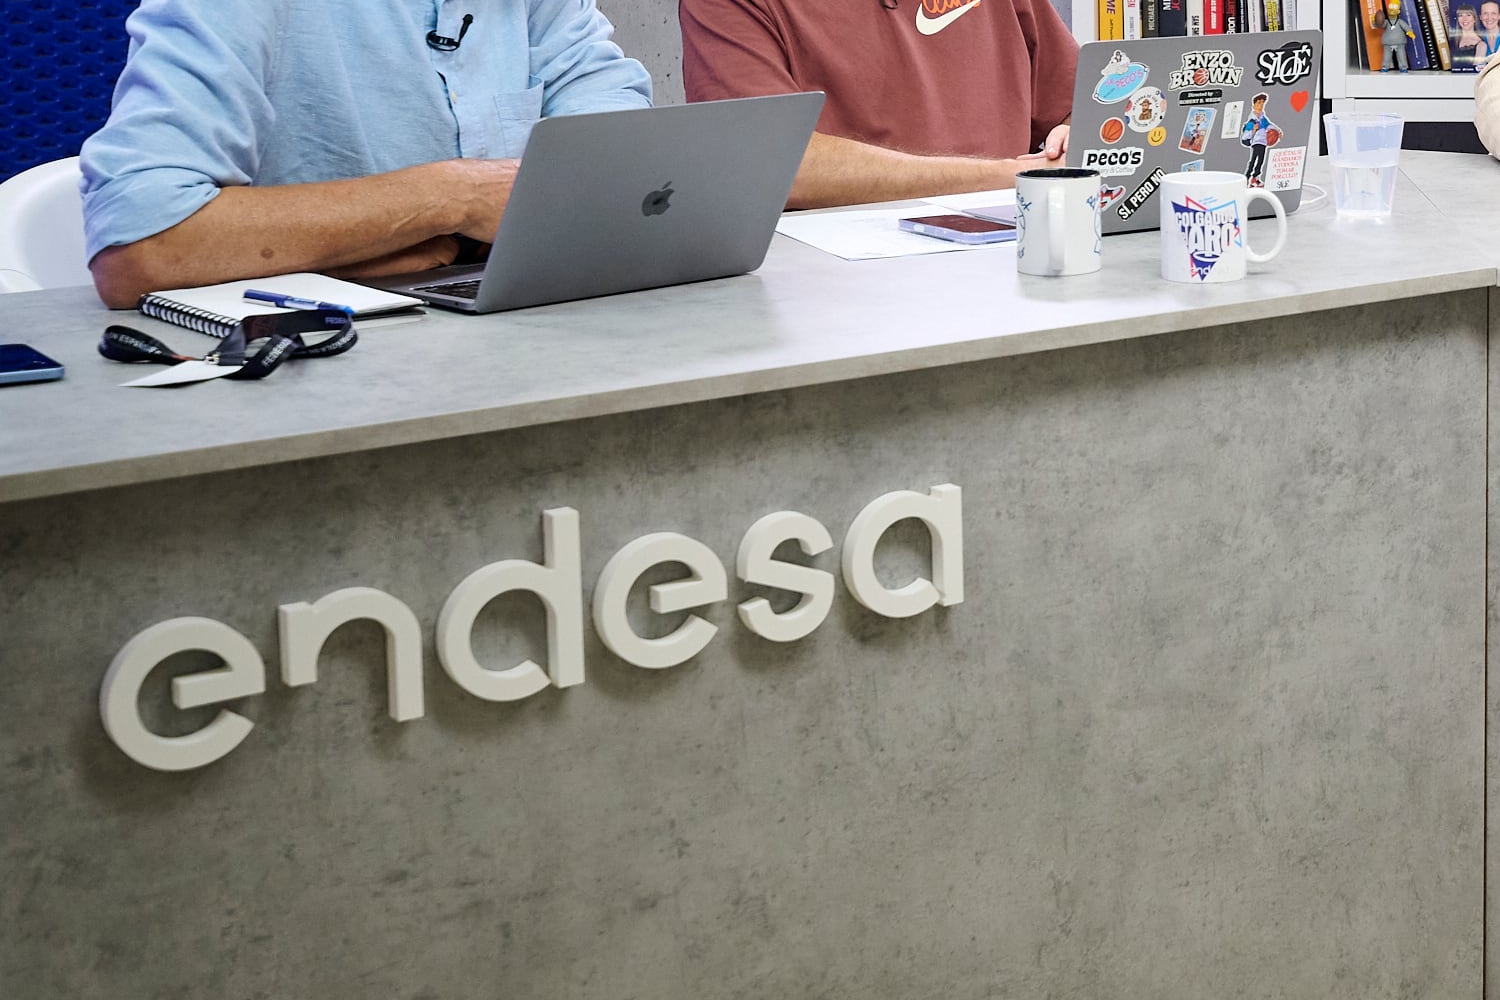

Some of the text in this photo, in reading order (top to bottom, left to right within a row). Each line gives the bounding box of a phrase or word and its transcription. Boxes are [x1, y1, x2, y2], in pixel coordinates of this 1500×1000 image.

[1183, 51, 1233, 70] ENZO
[1129, 180, 1154, 208] PERO
[1150, 168, 1167, 186] NO
[99, 482, 964, 772] endesa
